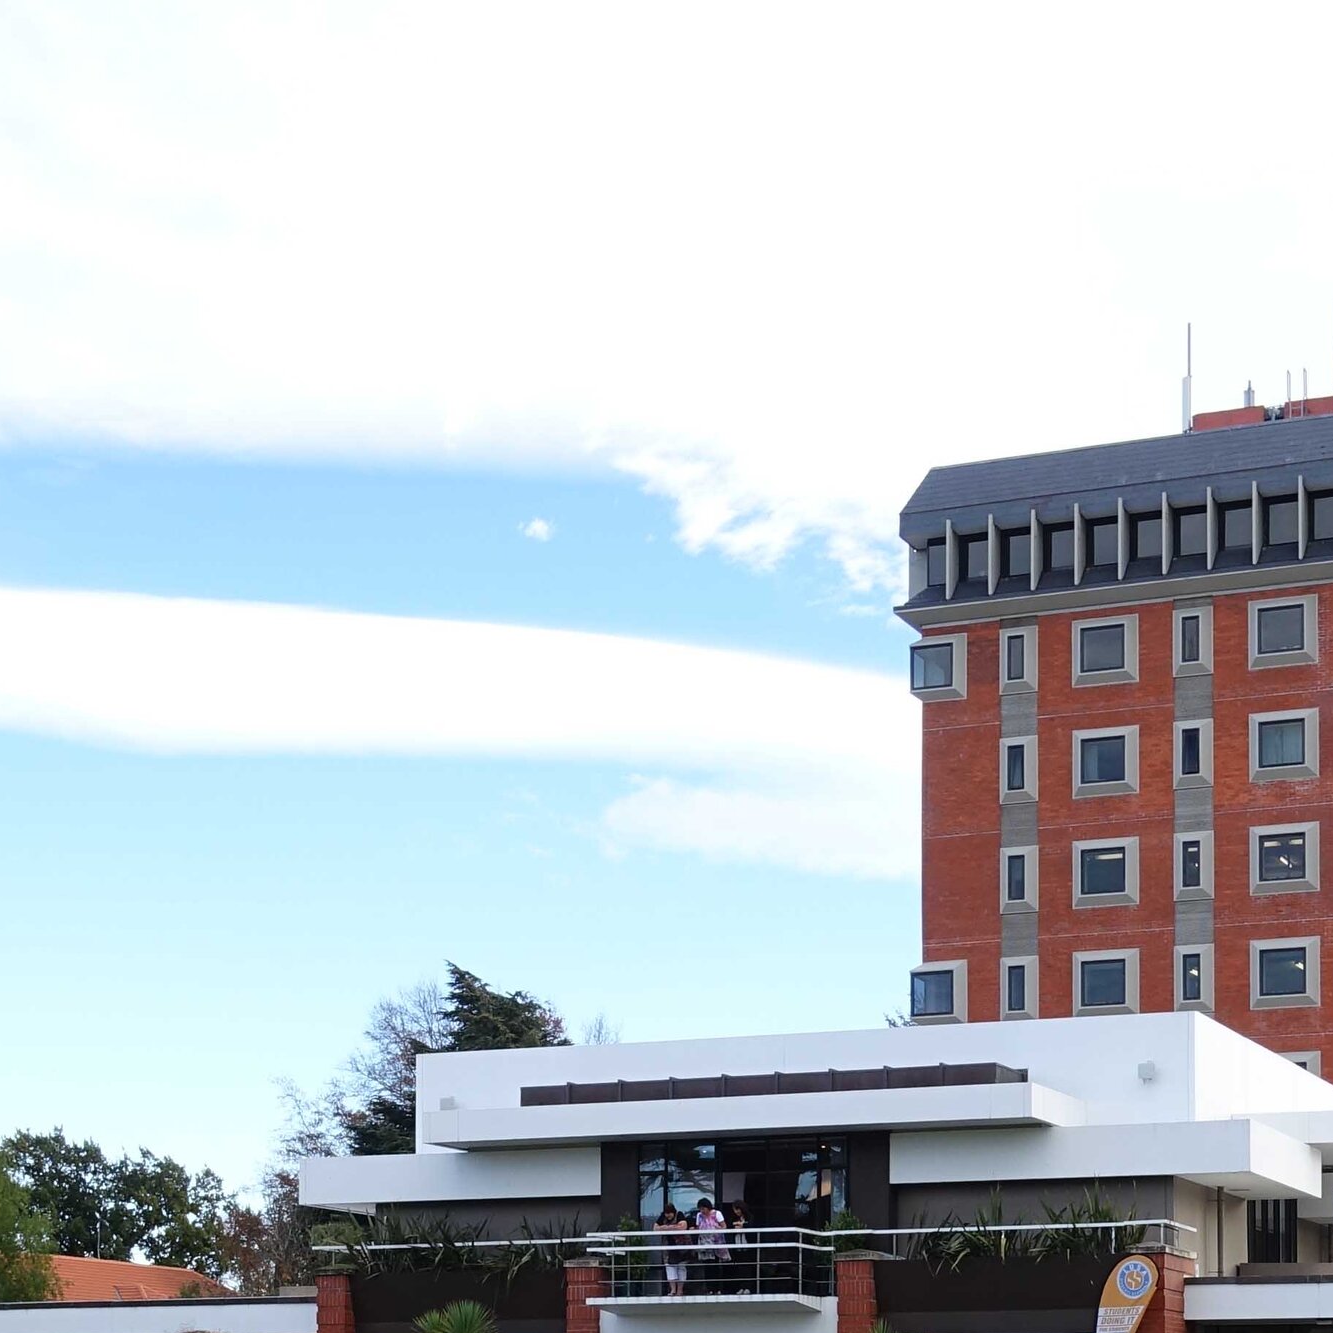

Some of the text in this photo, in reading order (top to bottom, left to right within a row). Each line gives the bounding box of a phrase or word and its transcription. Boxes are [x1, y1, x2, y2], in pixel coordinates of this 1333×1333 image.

[1104, 1306, 1141, 1315] STUDENTS
[1101, 1316, 1136, 1325] DOING IT
